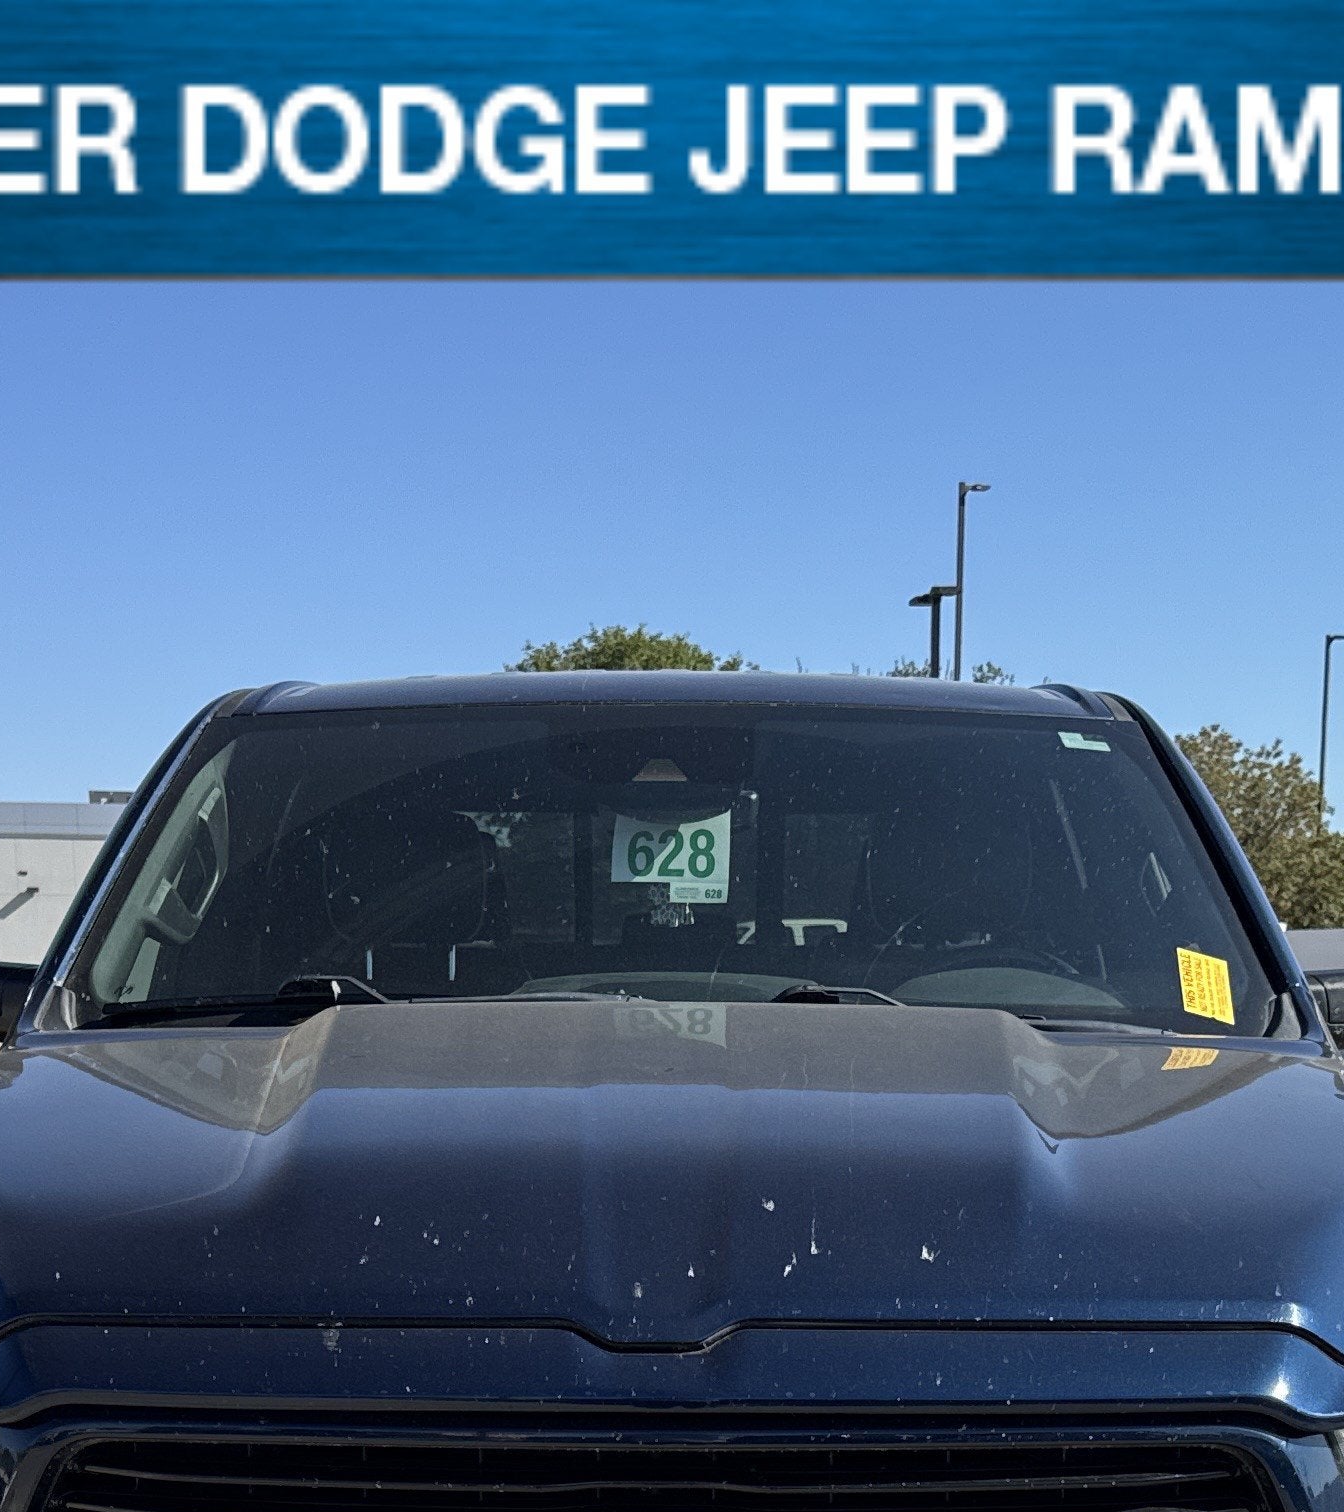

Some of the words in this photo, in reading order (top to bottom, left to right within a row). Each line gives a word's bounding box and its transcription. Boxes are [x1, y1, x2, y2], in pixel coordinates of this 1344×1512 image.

[628, 829, 715, 878] 628
[704, 888, 723, 899] 628
[1179, 952, 1193, 988] VEHICLE
